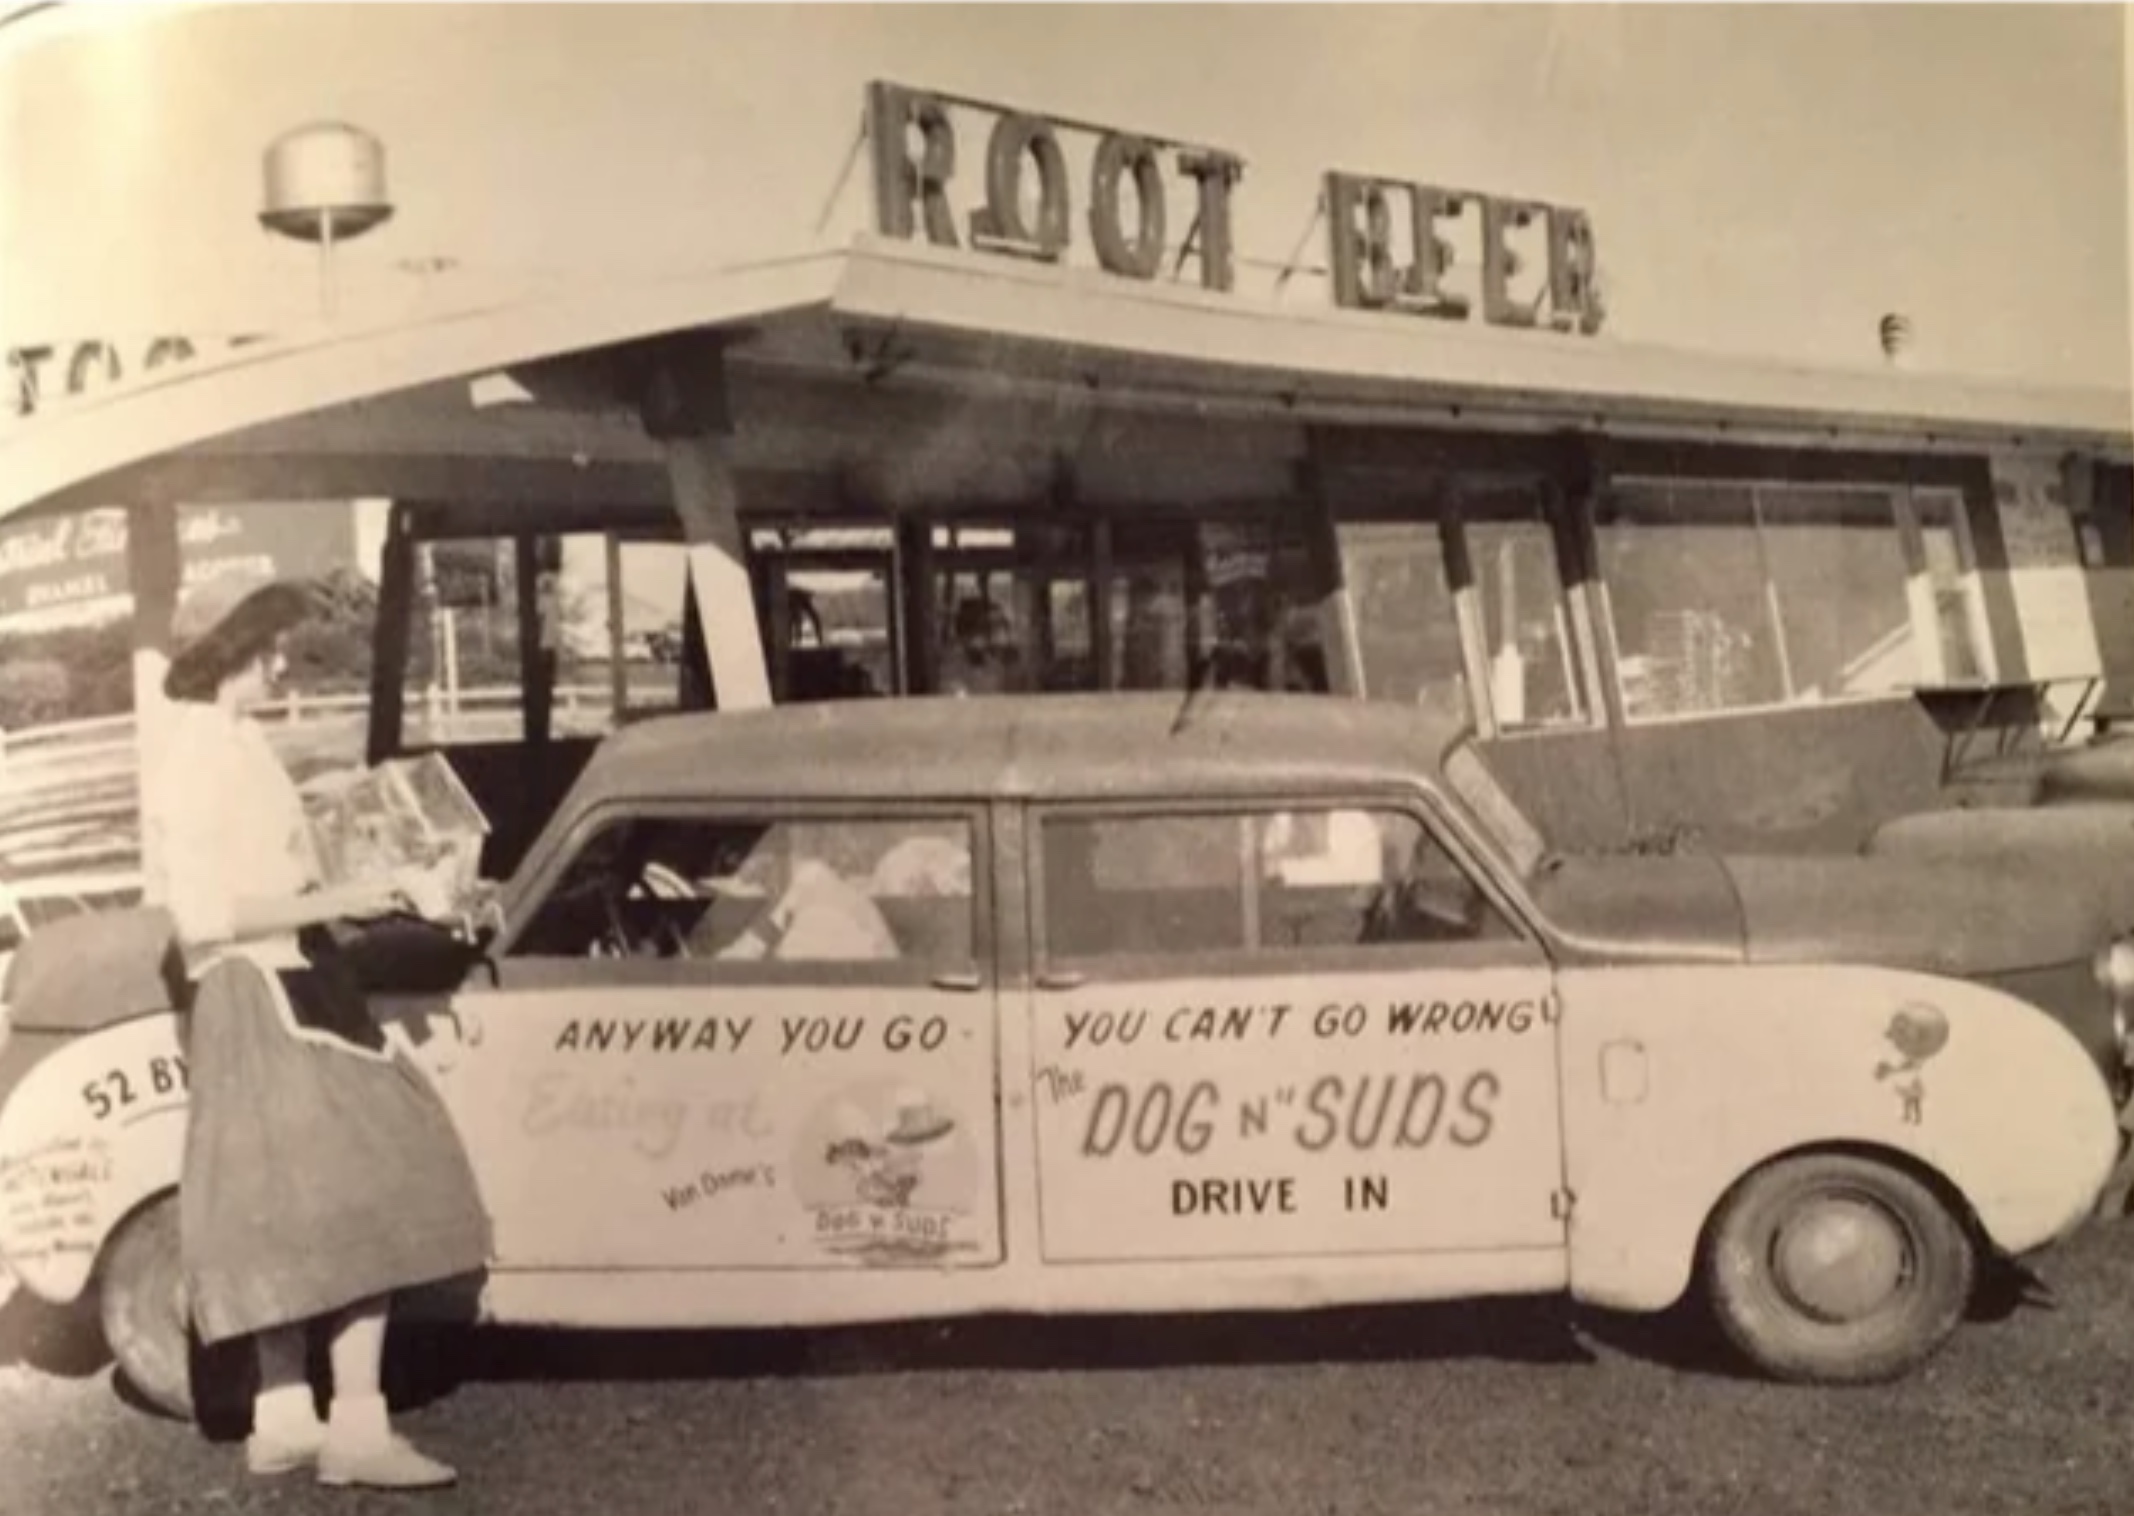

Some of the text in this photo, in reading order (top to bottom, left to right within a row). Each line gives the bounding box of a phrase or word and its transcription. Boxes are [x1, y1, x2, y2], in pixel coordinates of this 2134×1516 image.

[865, 79, 1604, 335] ROOT BEER
[556, 1015, 948, 1054] ANYWAY YOU GO
[1063, 1000, 1534, 1048] YOU CAN'T GO WRONG
[83, 1069, 137, 1120] 52
[1081, 1080, 1219, 1157] DOG
[1294, 1069, 1501, 1151] SUDS
[1172, 1176, 1389, 1216] DRIVE IN
